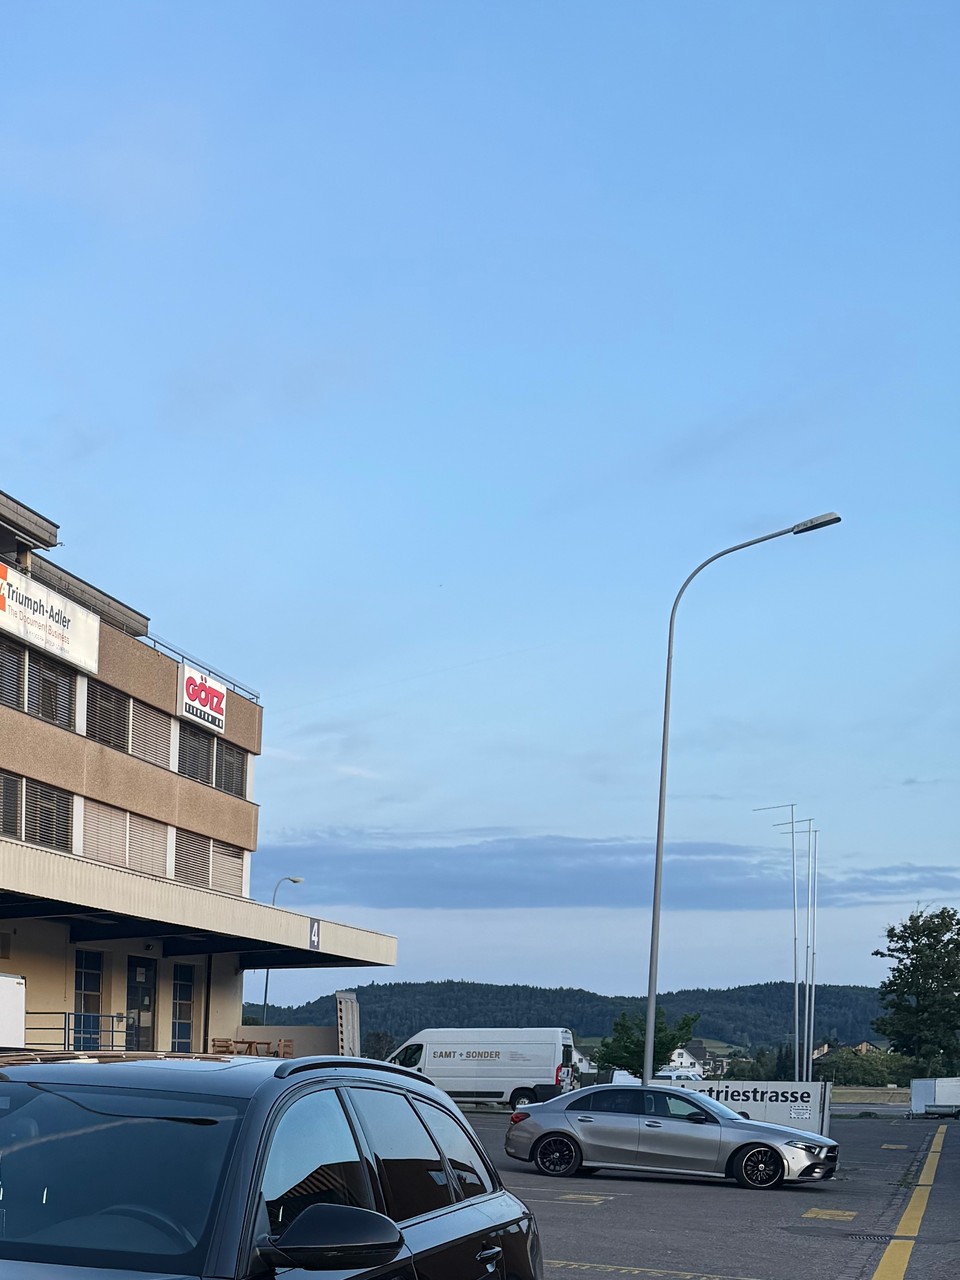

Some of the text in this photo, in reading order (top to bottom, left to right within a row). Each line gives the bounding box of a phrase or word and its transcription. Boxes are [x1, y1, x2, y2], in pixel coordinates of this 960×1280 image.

[6, 582, 71, 630] Triumph-Adler
[8, 604, 18, 619] The
[19, 610, 47, 634] Document
[48, 625, 70, 645] Business
[185, 675, 225, 716] GÖTZ
[312, 922, 319, 945] 4
[432, 1051, 457, 1059] SAMT
[465, 1051, 501, 1059] SONDER
[681, 1084, 811, 1103] triestrasse
